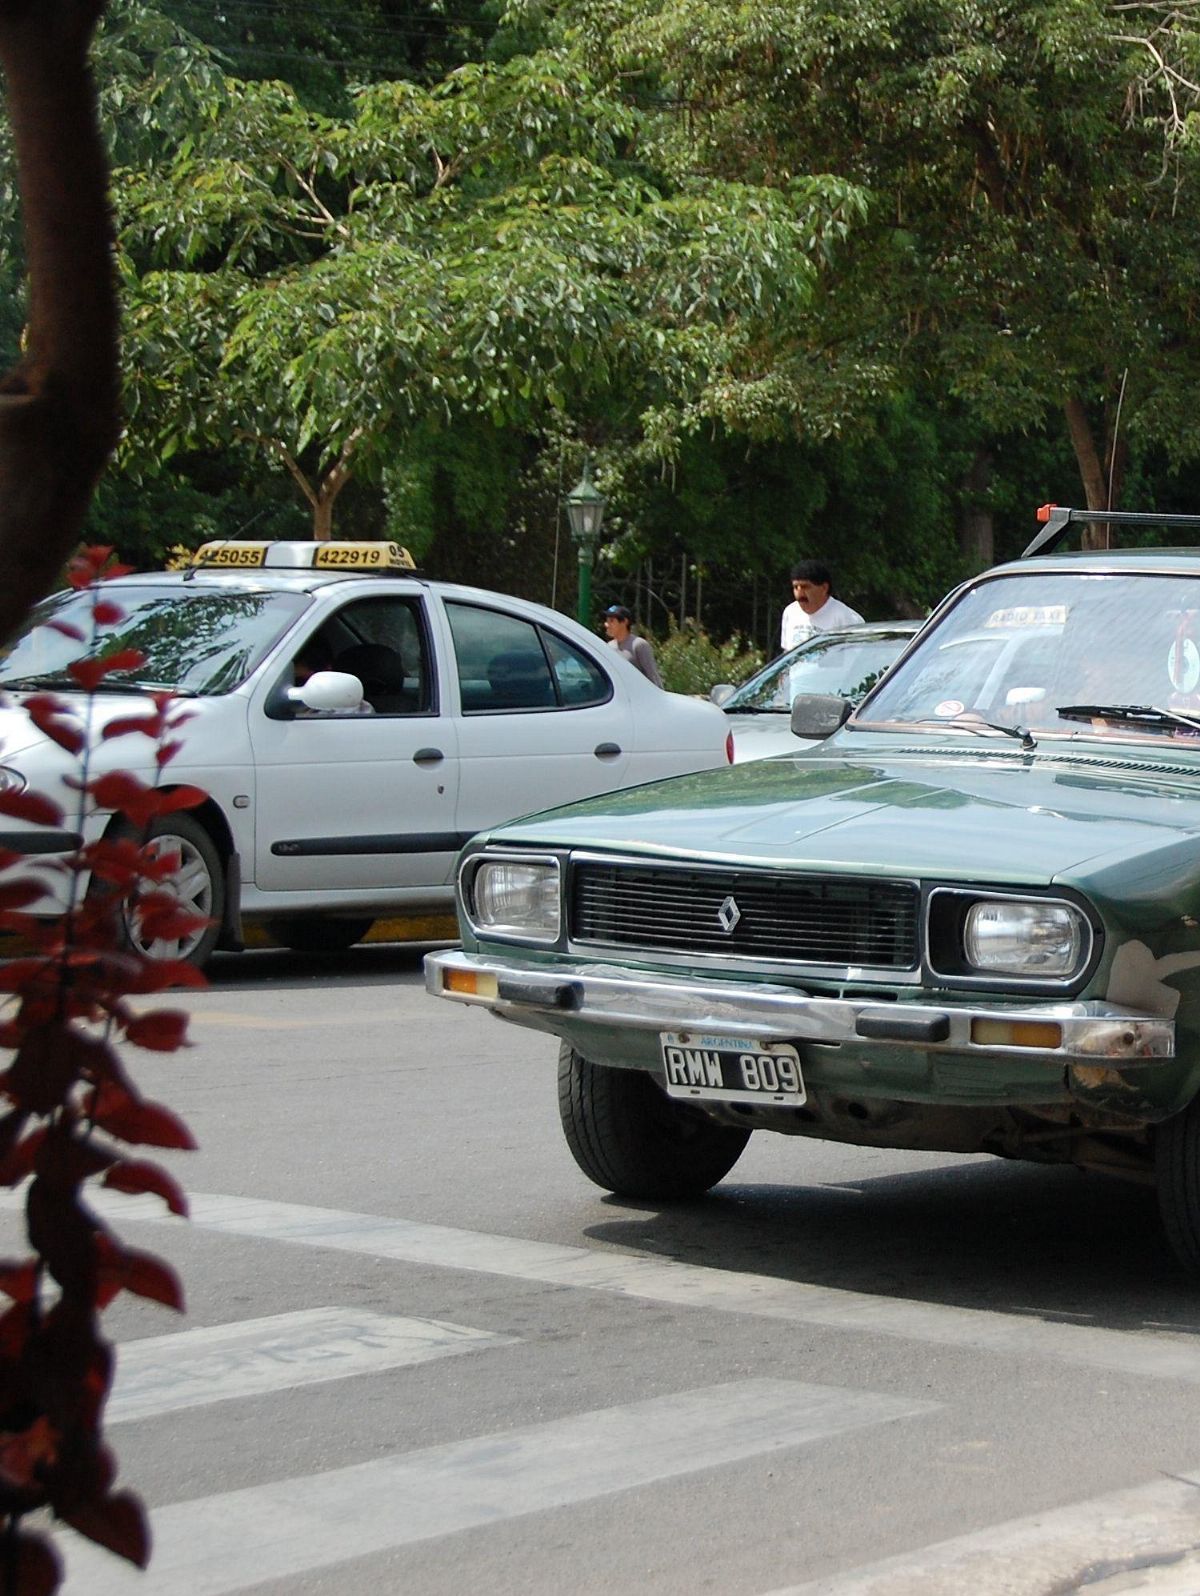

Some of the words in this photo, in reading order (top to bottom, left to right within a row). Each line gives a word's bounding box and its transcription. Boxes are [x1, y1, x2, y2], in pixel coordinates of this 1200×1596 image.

[199, 549, 260, 563] 425055
[319, 549, 380, 564] 422919
[389, 545, 404, 558] 05
[701, 1036, 753, 1049] ARGENTINA
[667, 1047, 723, 1088] RMW
[739, 1054, 799, 1092] 809
